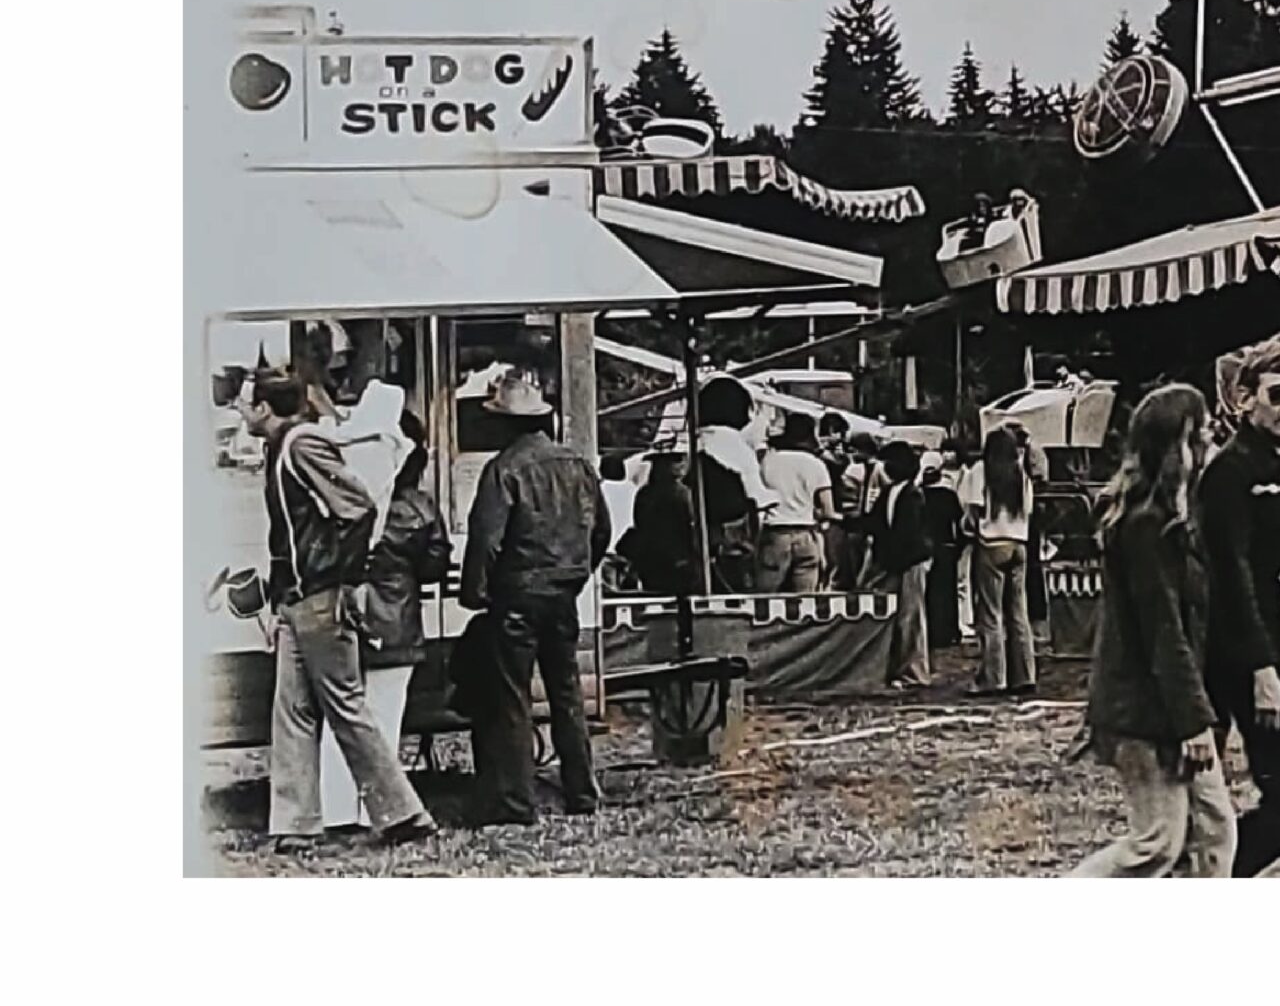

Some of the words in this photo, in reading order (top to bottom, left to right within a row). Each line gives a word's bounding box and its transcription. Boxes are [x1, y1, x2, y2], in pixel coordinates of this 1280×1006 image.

[320, 54, 414, 86] HOT
[429, 53, 525, 85] DOG
[379, 86, 409, 99] on
[340, 101, 497, 134] STICK
